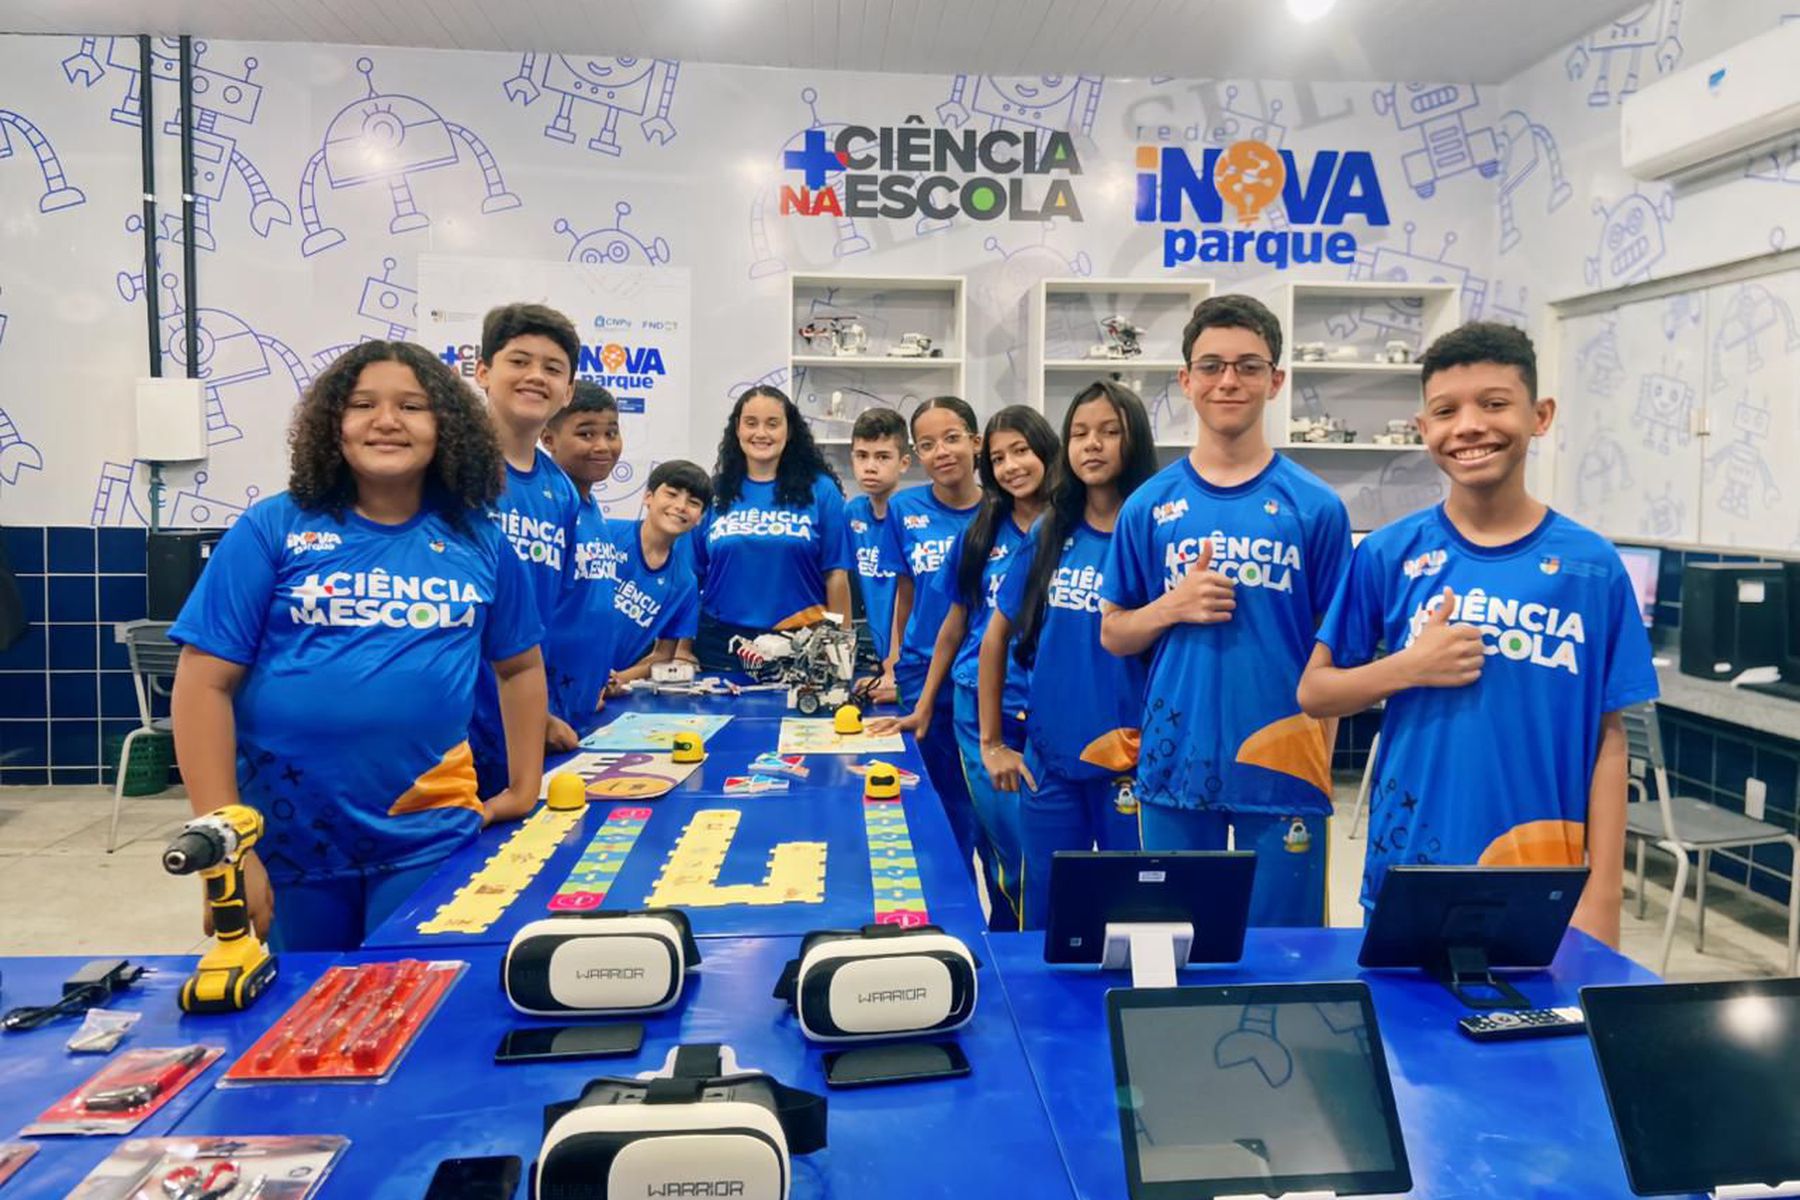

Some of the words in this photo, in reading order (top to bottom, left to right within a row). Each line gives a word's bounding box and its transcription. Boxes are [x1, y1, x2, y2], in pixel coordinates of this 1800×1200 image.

[1163, 228, 1356, 269] parque
[576, 968, 645, 980] WARRIOR
[858, 987, 927, 1004] WARRIOR
[648, 1181, 744, 1197] WARRIOR
